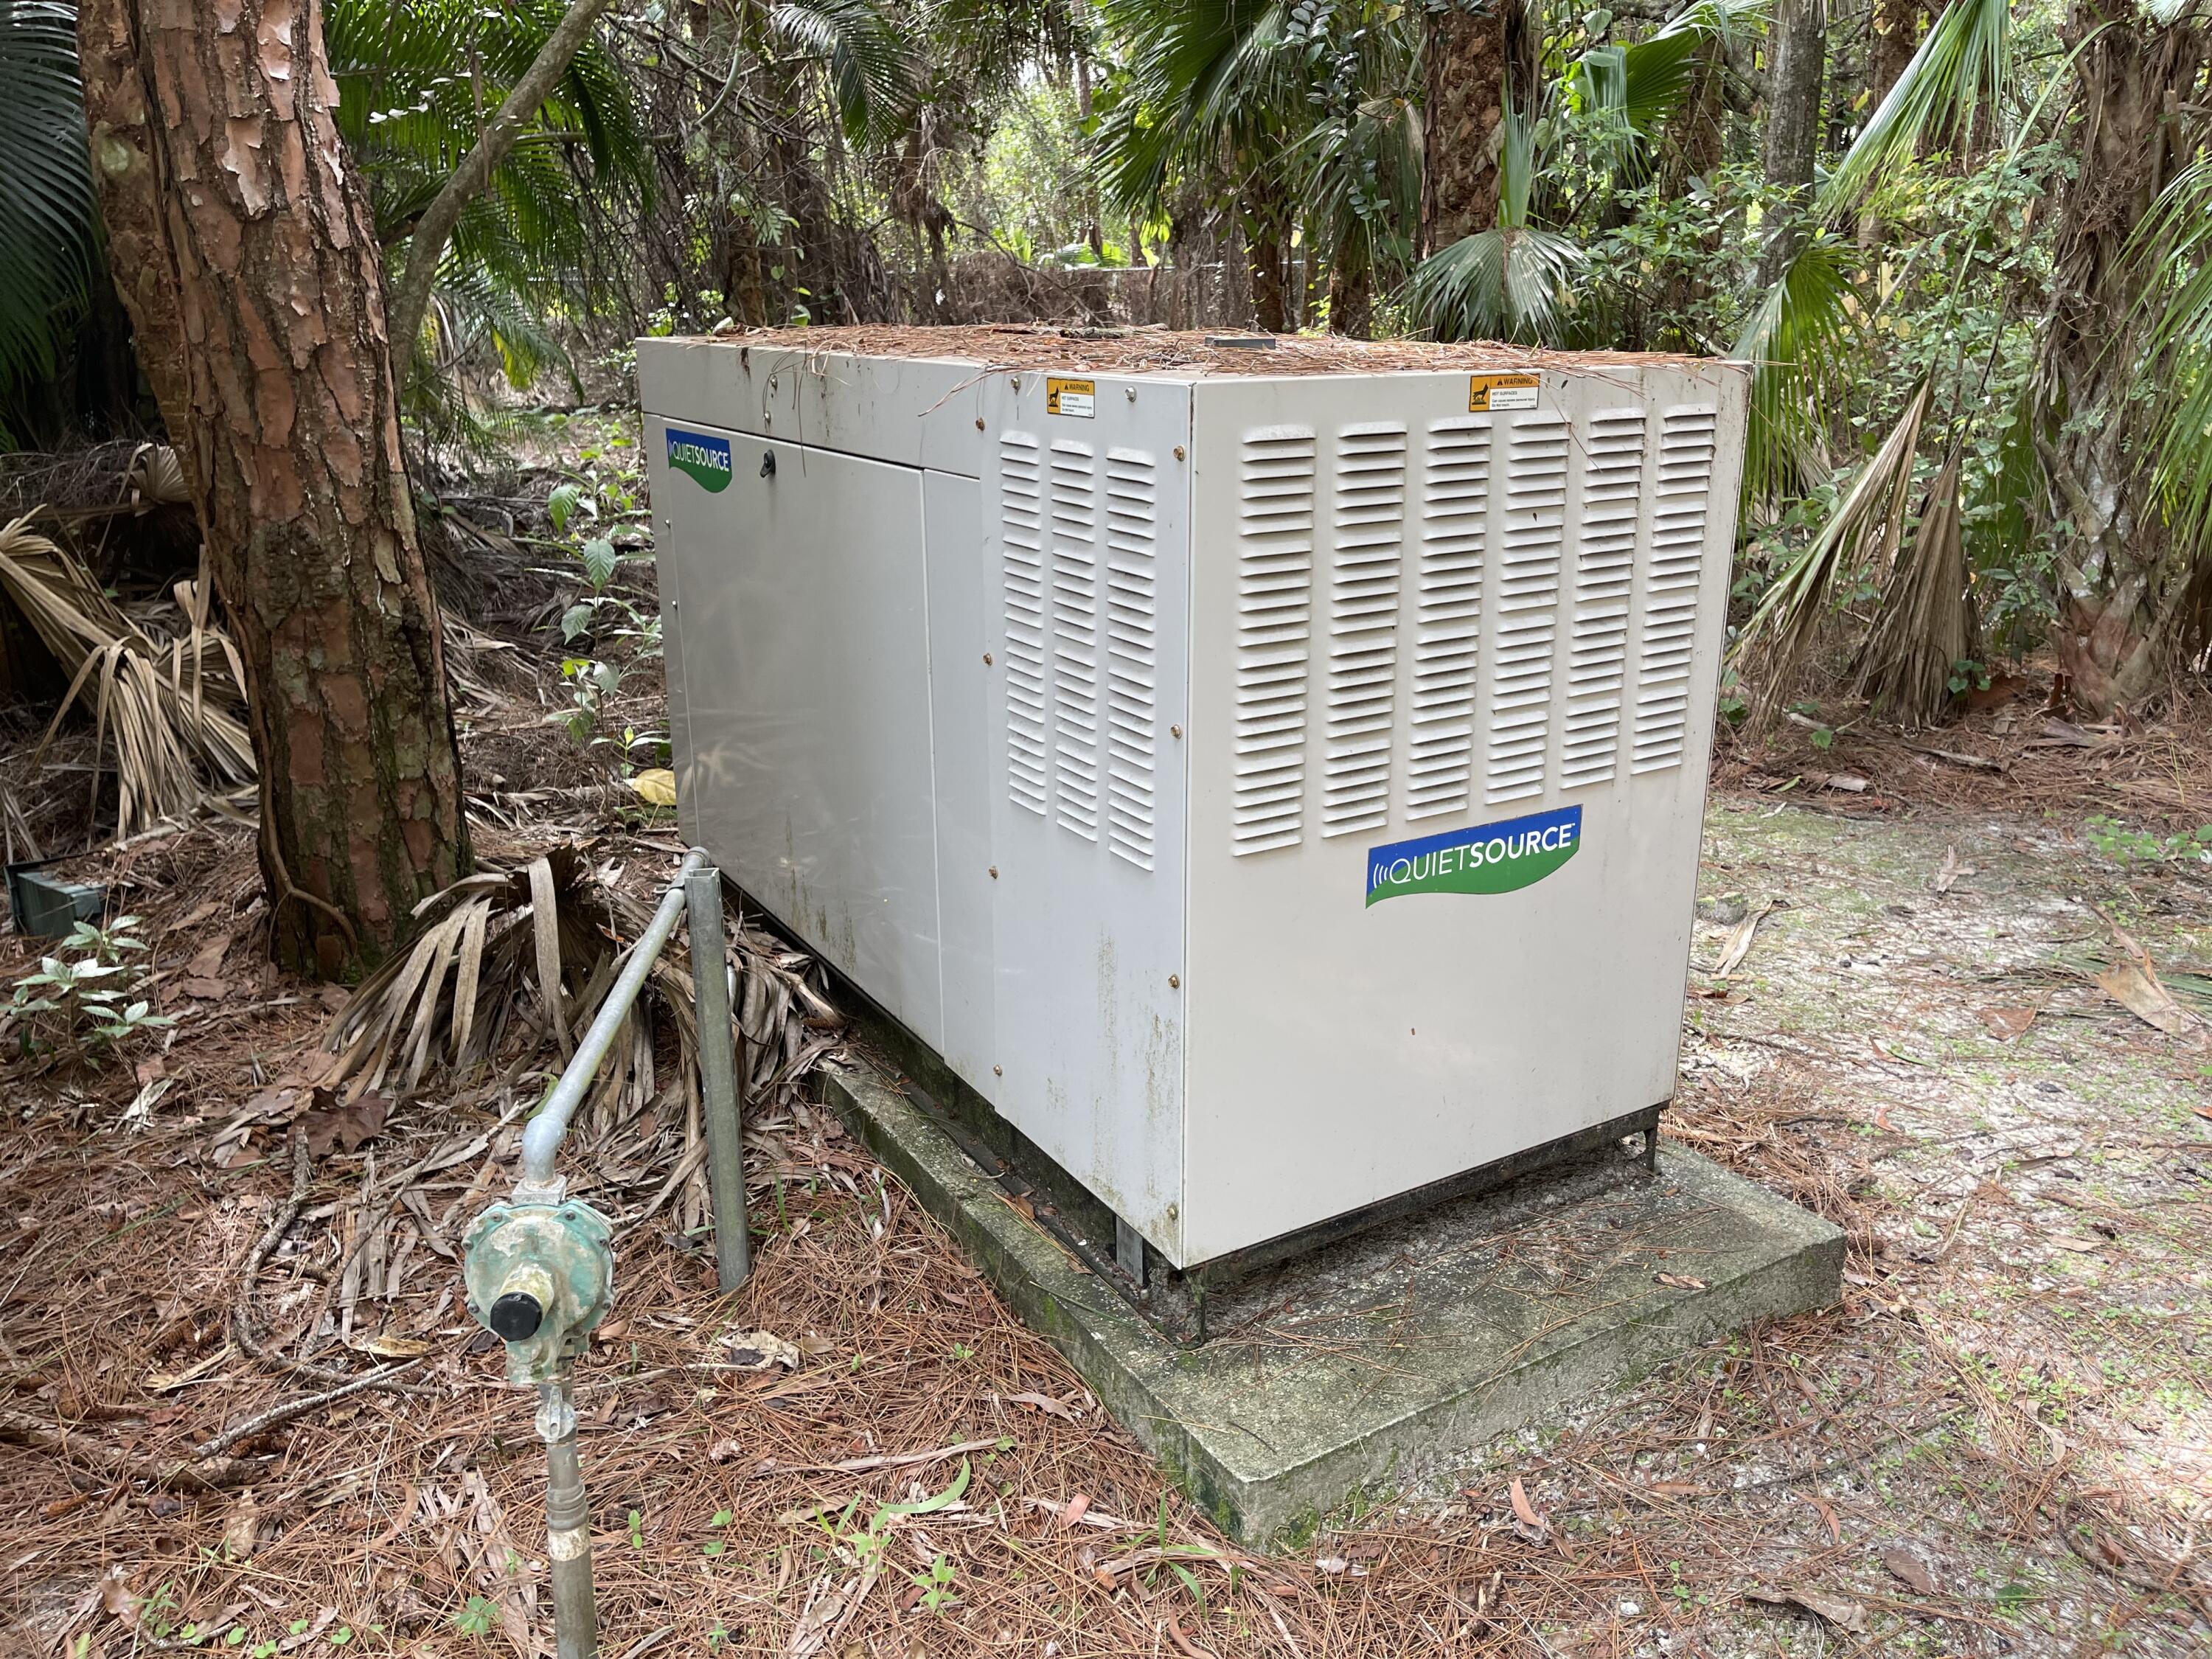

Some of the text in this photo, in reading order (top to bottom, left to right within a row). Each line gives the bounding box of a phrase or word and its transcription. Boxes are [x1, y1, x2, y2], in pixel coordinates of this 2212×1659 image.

[1069, 383, 1090, 392] WARNING
[1503, 378, 1533, 386] WARNING
[672, 441, 729, 472] QUIETSOURCE
[1389, 824, 1572, 884] QUIETSOURCE
